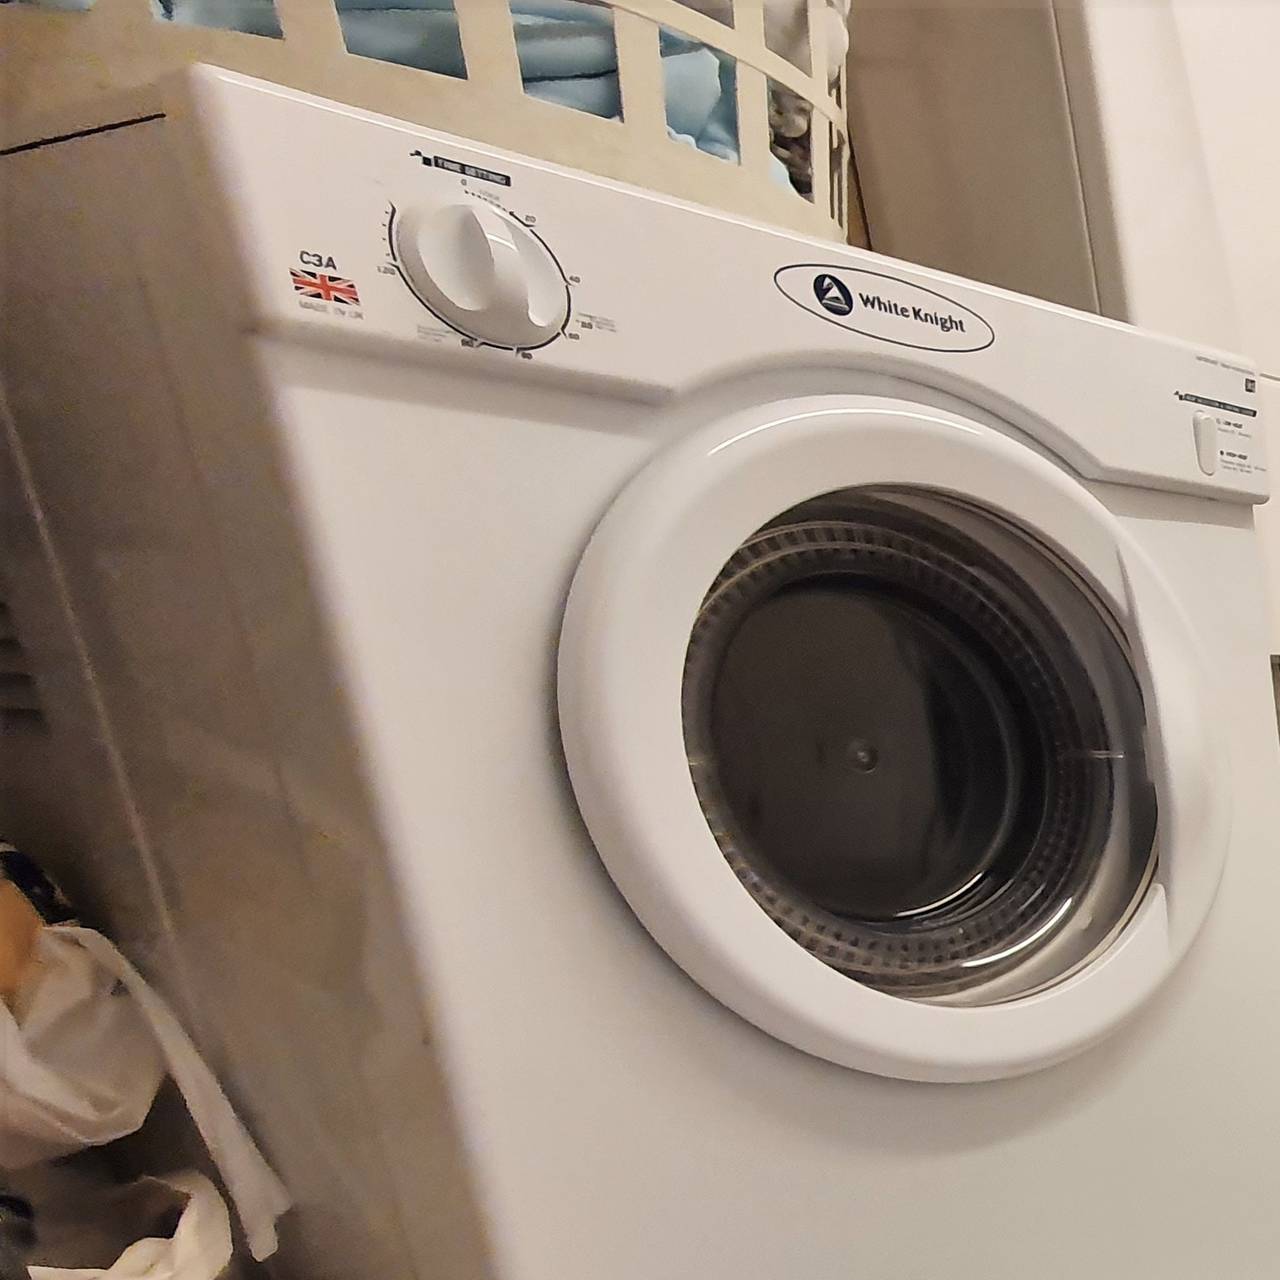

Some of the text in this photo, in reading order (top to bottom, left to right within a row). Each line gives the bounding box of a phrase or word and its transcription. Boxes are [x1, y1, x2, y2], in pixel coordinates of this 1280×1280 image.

[299, 250, 337, 271] C3A
[858, 292, 967, 333] White Knight
